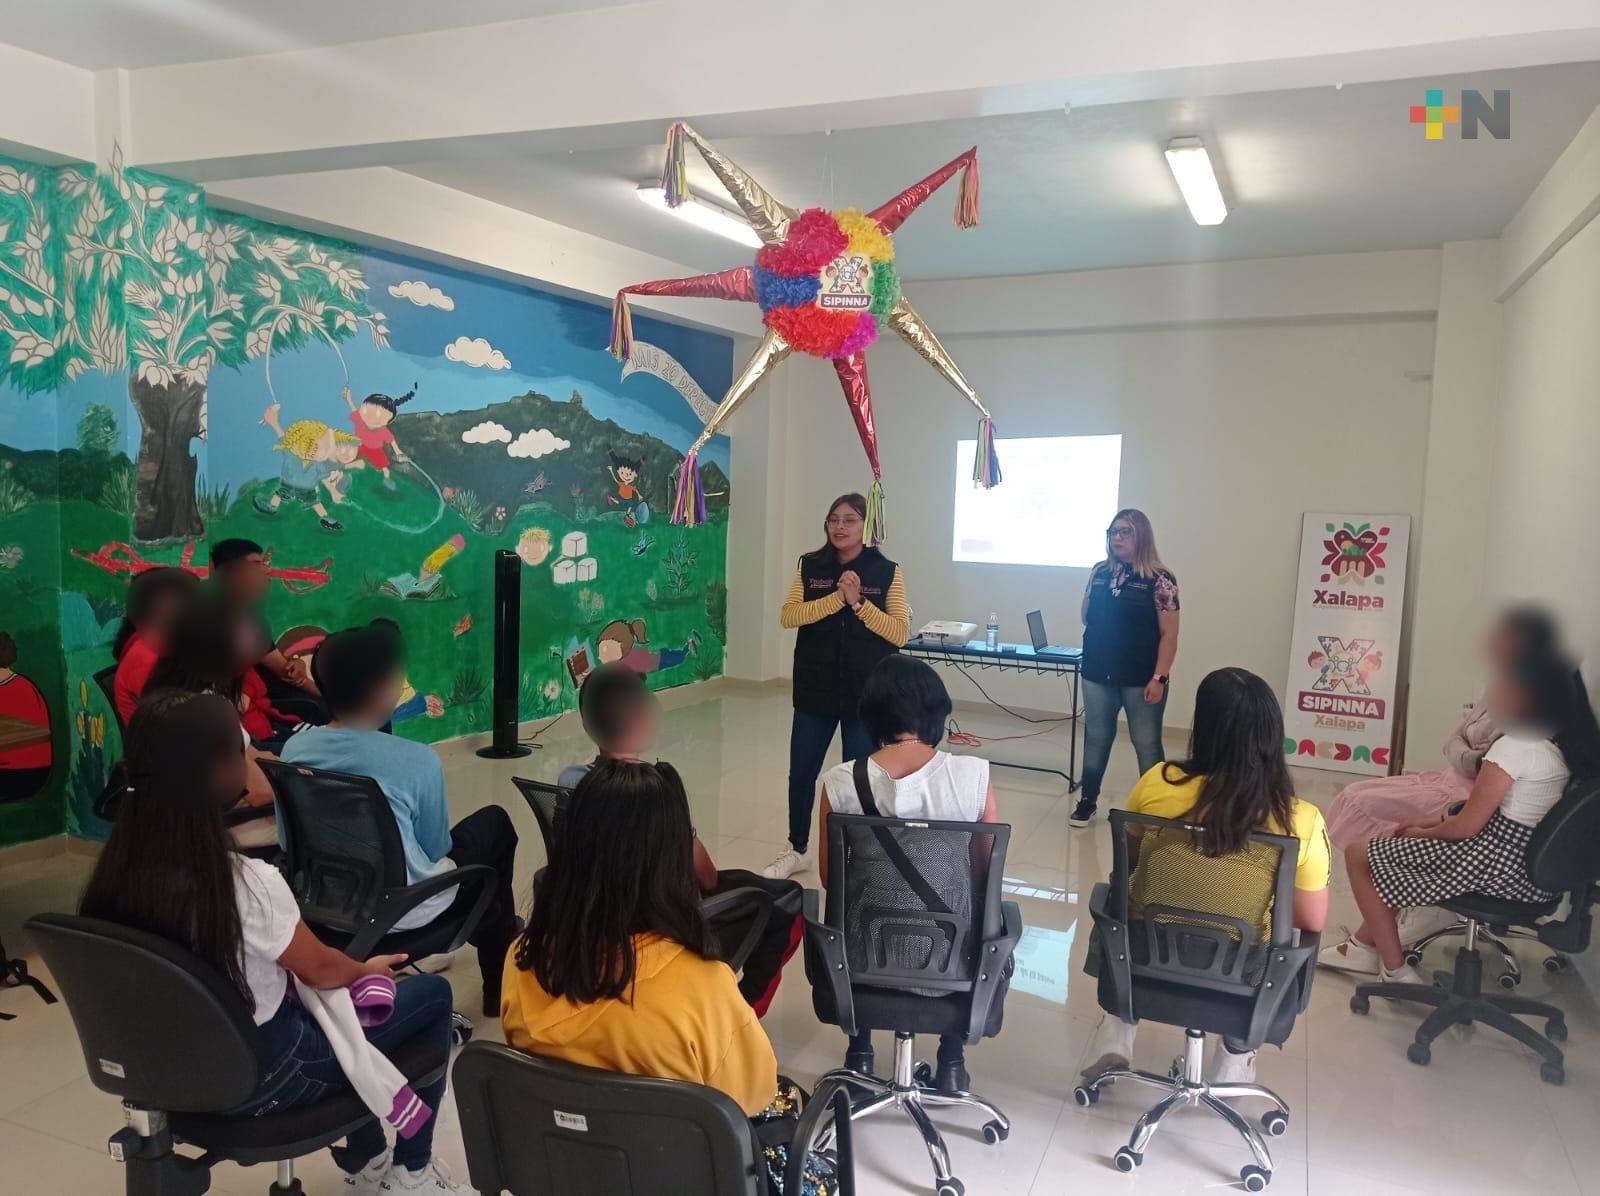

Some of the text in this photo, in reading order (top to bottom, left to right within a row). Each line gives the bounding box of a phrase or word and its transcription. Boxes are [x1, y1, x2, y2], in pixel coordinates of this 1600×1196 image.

[823, 296, 868, 306] SIPINNA
[1312, 589, 1384, 611] Xalapa
[1302, 695, 1379, 716] SIPINNA
[1314, 714, 1366, 731] Xalapa
